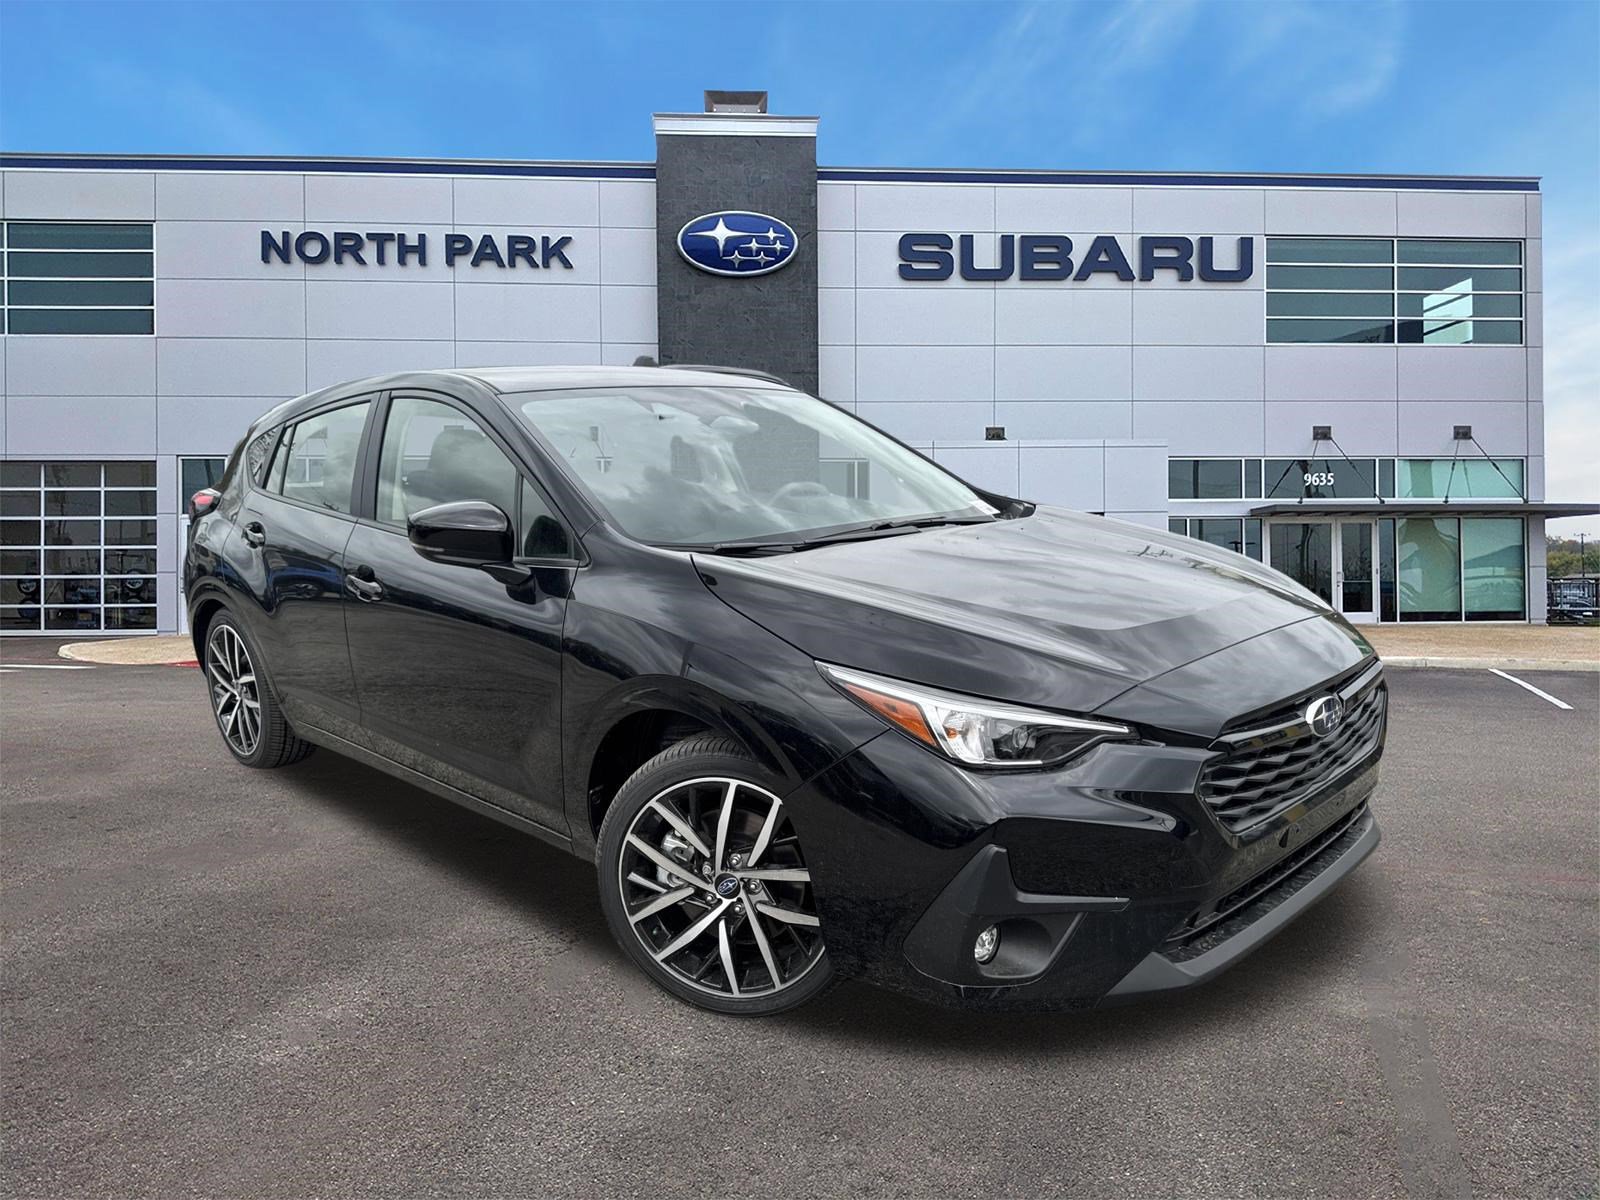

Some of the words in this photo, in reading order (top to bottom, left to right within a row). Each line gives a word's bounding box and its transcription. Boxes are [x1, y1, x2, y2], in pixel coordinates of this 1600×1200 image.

[261, 230, 427, 266] NORTH
[445, 233, 574, 269] PARK
[898, 233, 1254, 282] SUBARU
[1303, 472, 1335, 486] 9635
